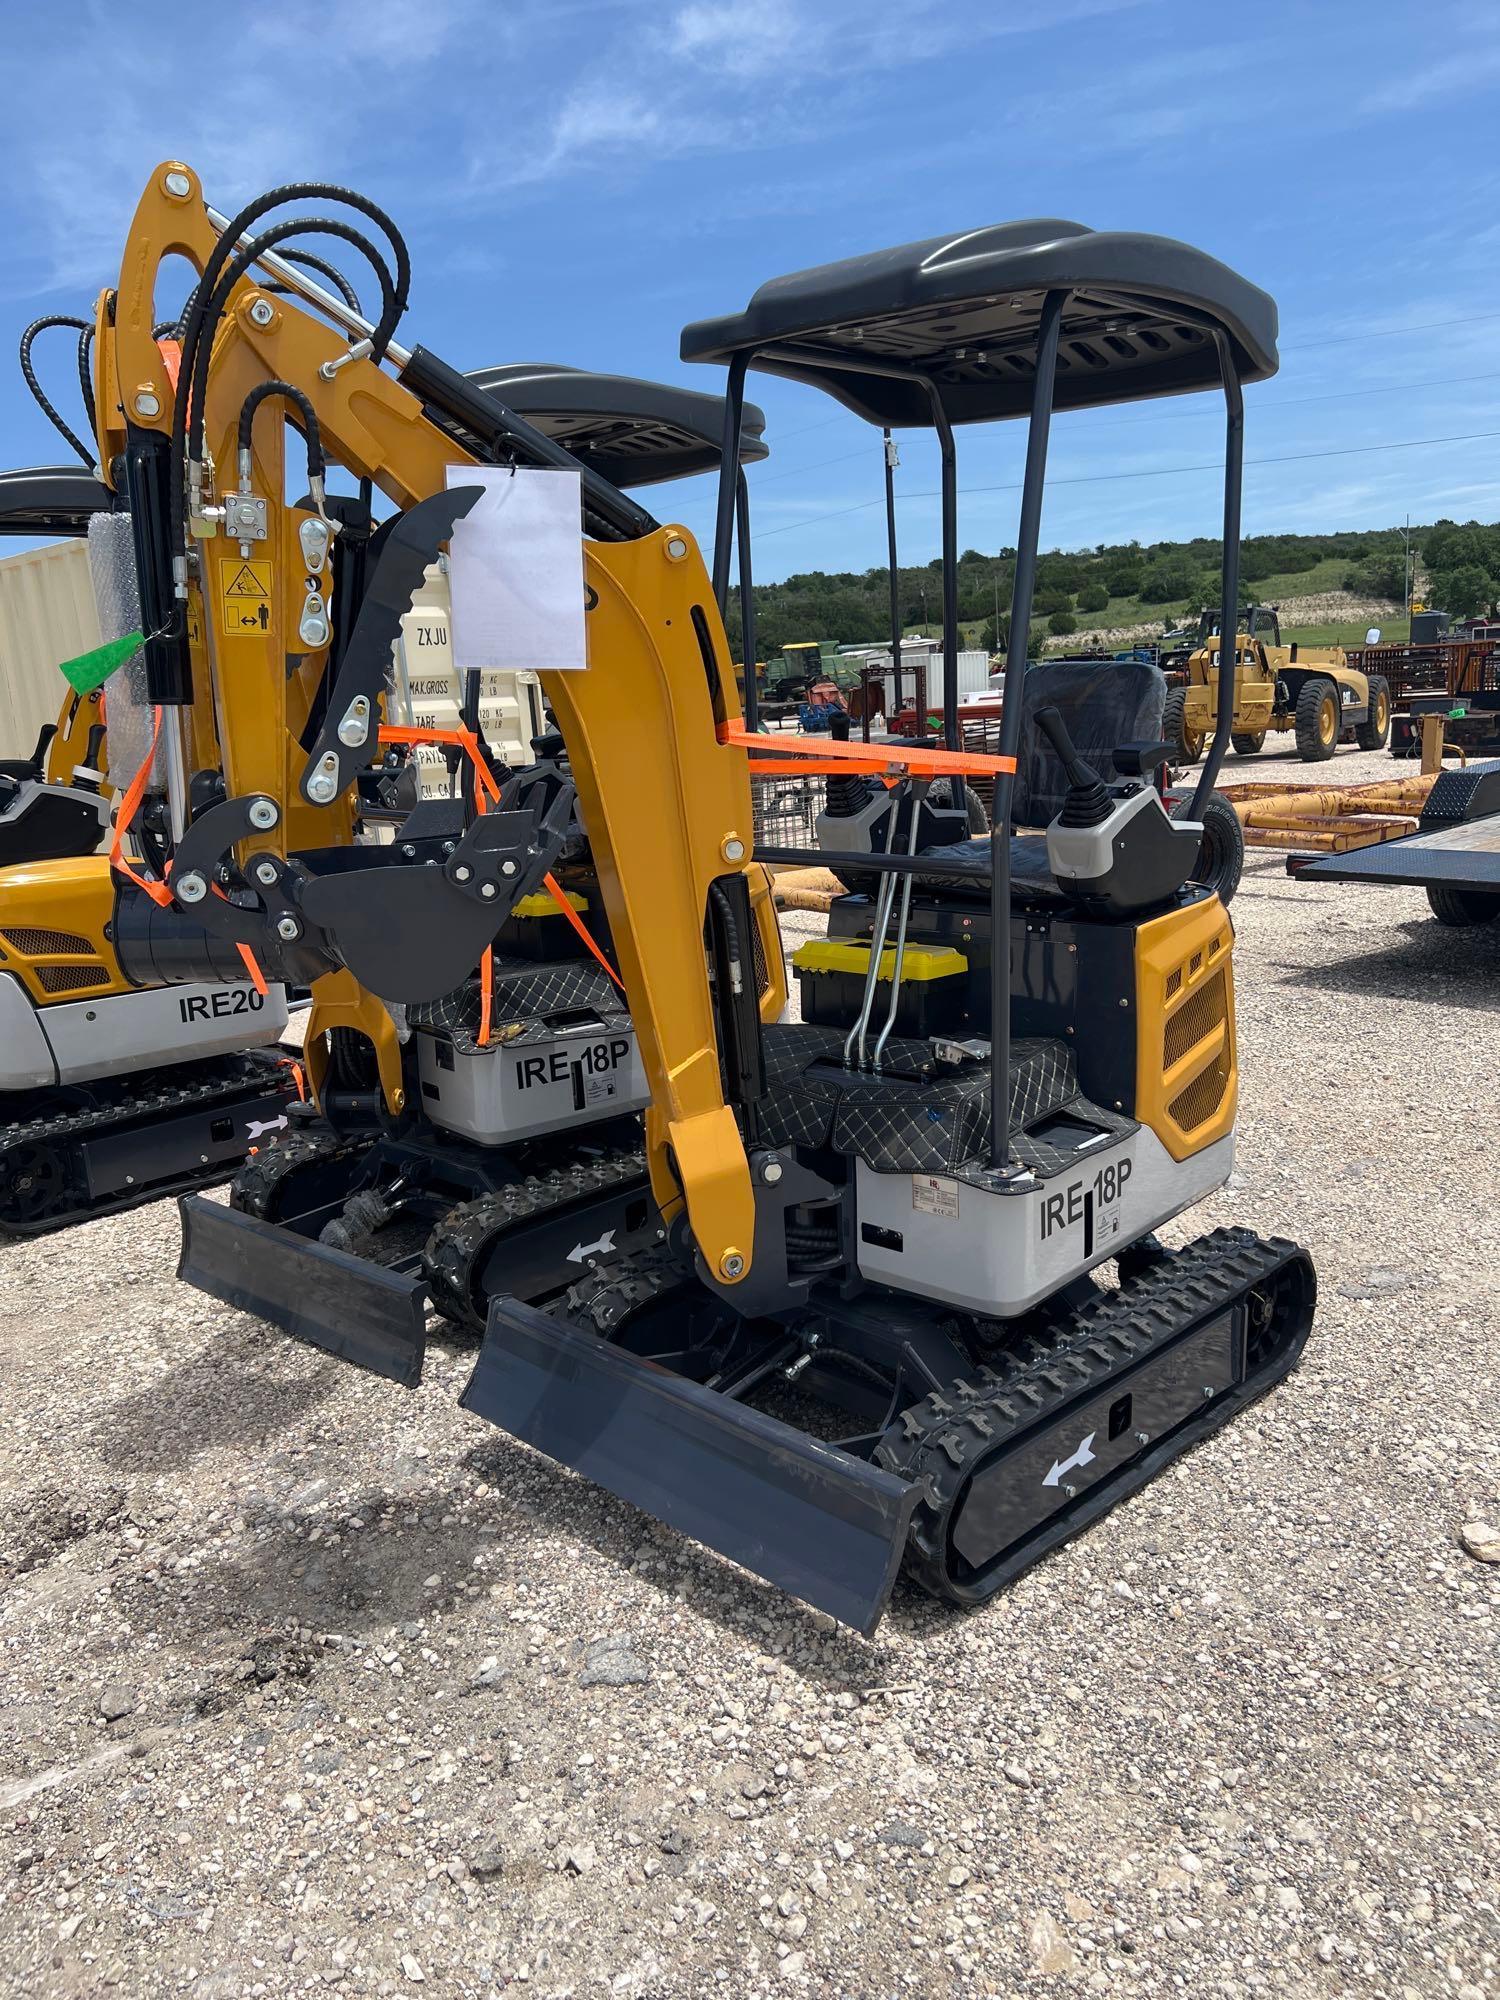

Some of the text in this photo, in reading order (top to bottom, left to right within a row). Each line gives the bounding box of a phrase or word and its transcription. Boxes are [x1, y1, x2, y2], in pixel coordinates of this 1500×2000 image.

[417, 627, 447, 646] ZXJU
[490, 676, 498, 684] KG
[490, 686, 497, 695] LB
[496, 709, 503, 718] KG
[416, 715, 436, 729] TARE
[495, 721, 502, 729] LB
[179, 987, 264, 1023] IRE20
